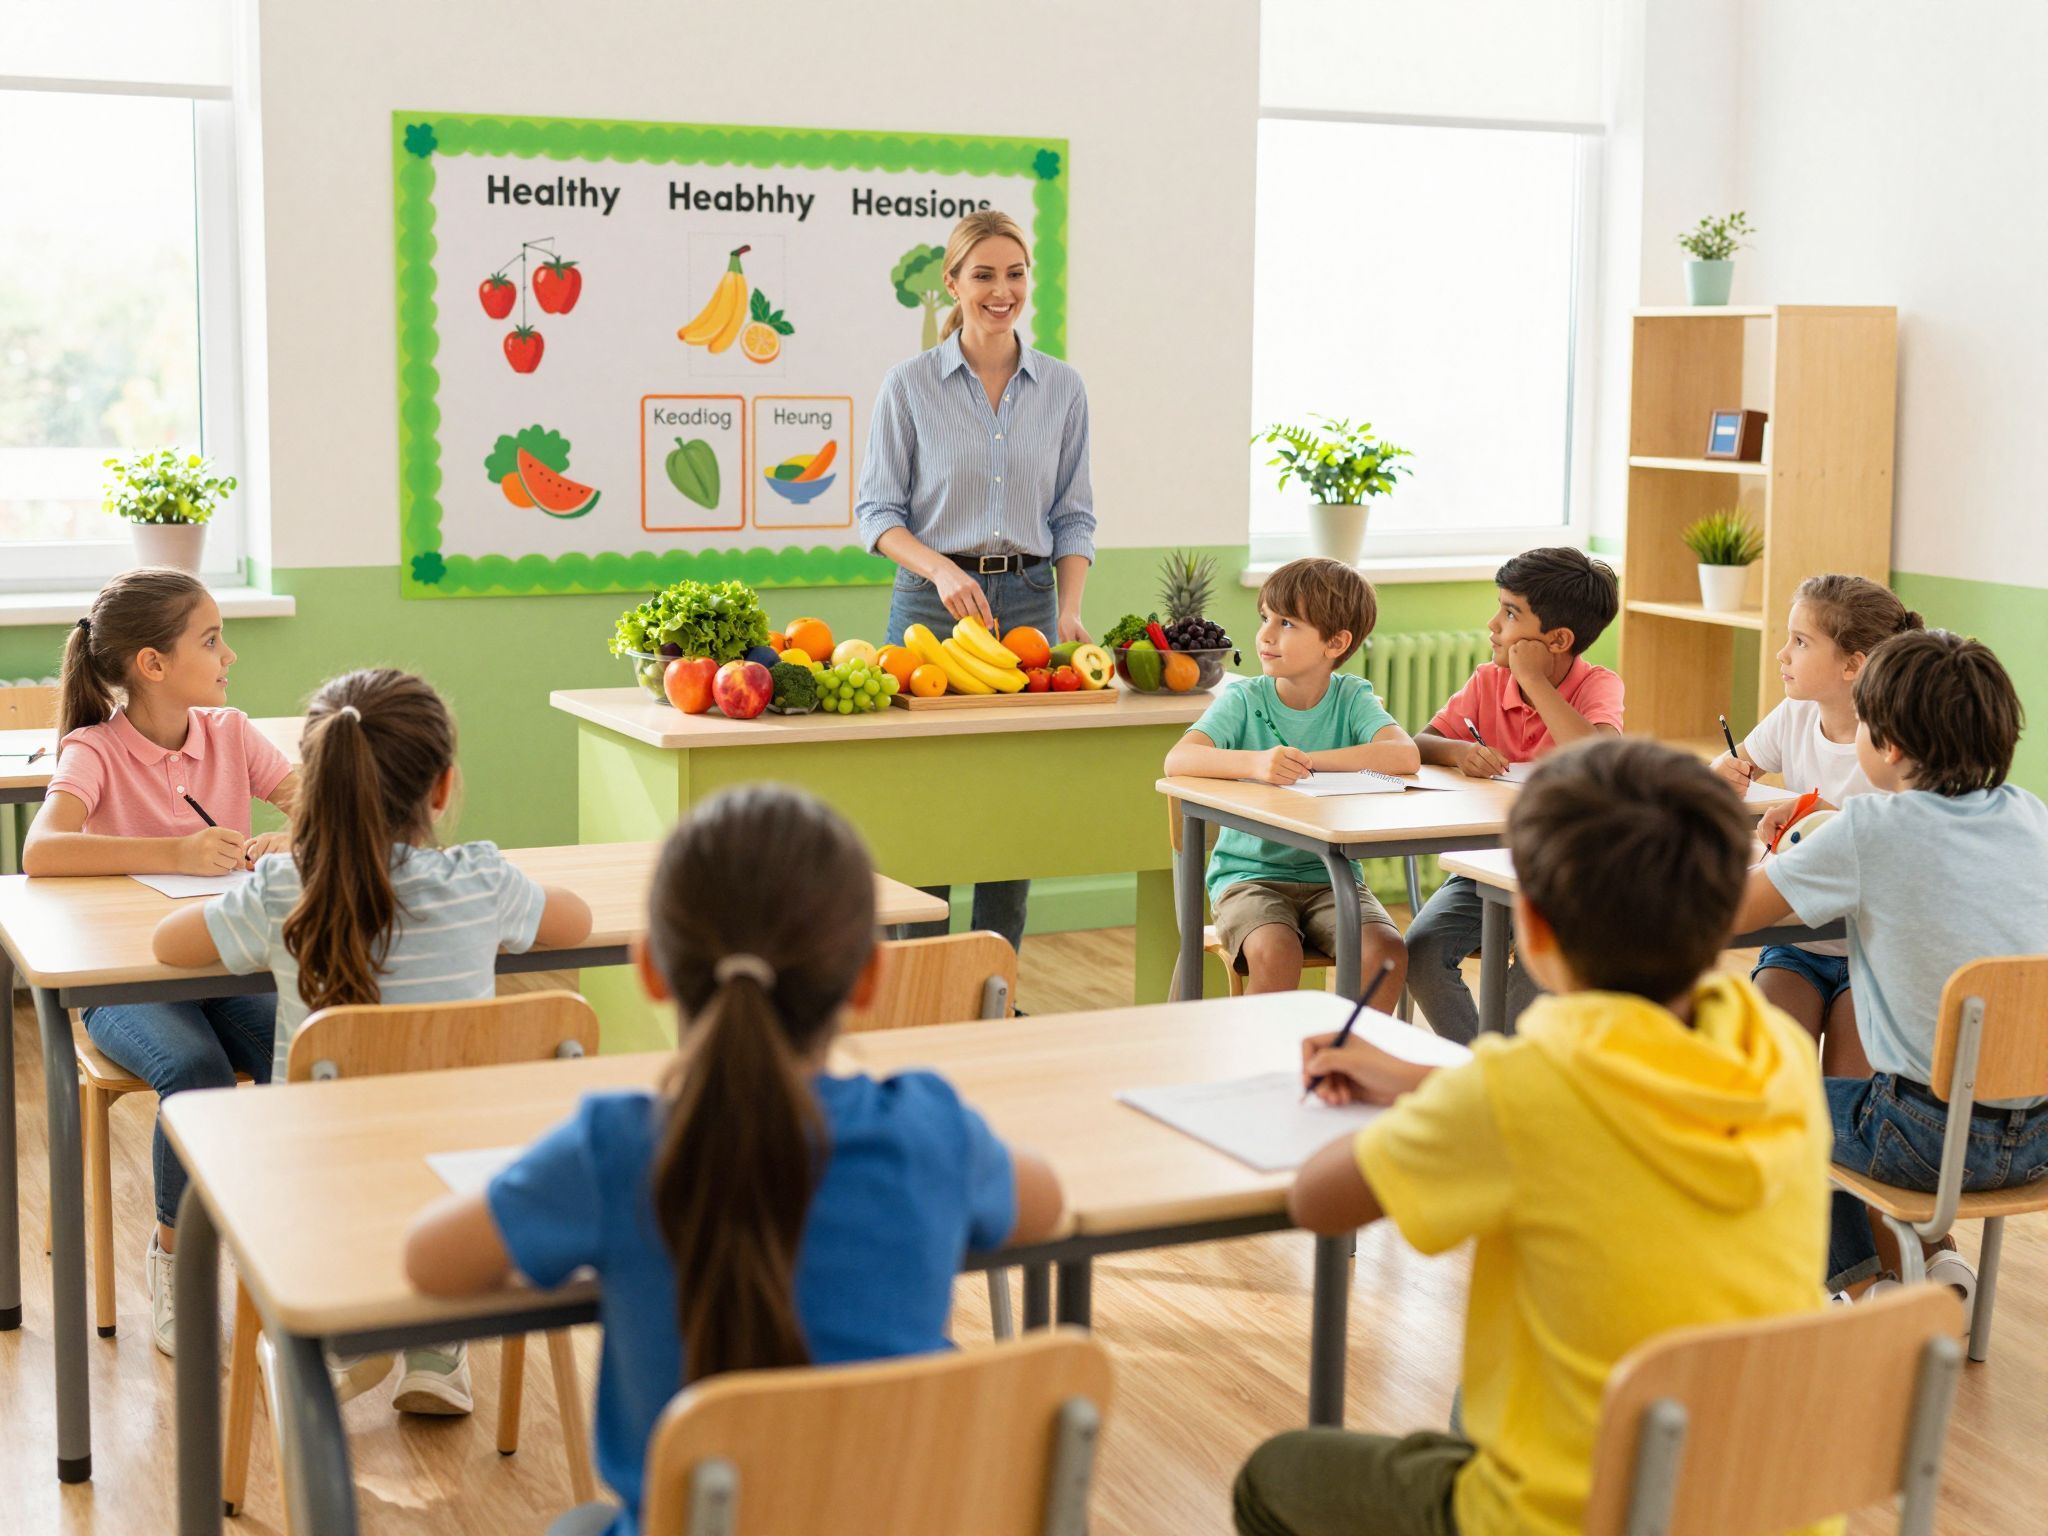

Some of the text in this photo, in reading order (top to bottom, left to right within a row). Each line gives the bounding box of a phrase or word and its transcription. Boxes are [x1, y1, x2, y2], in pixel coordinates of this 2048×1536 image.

[487, 174, 620, 216] Healthy
[669, 181, 815, 222] Heabhhy
[774, 408, 832, 430] Heung
